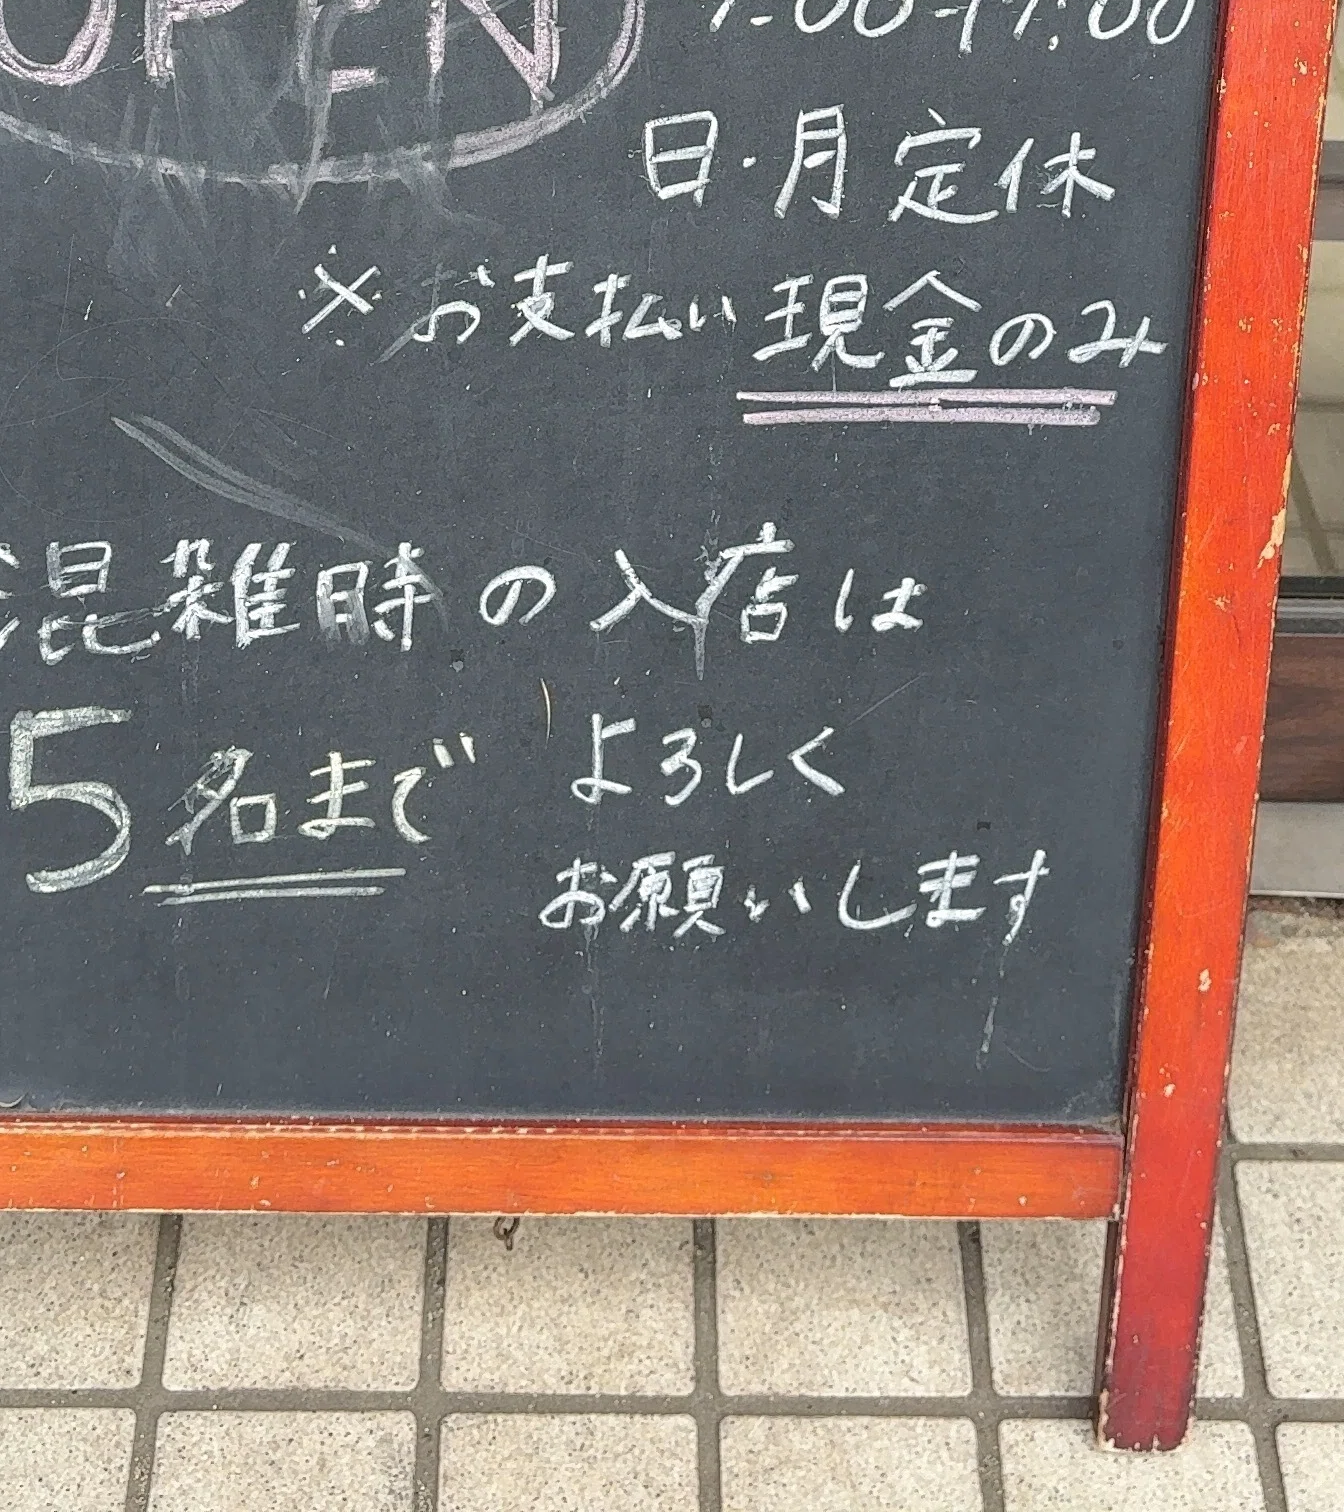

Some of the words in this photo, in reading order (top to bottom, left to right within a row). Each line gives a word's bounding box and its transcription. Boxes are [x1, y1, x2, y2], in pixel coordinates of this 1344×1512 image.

[569, 712, 846, 808] よろしく
[537, 848, 1051, 945] お願いします
